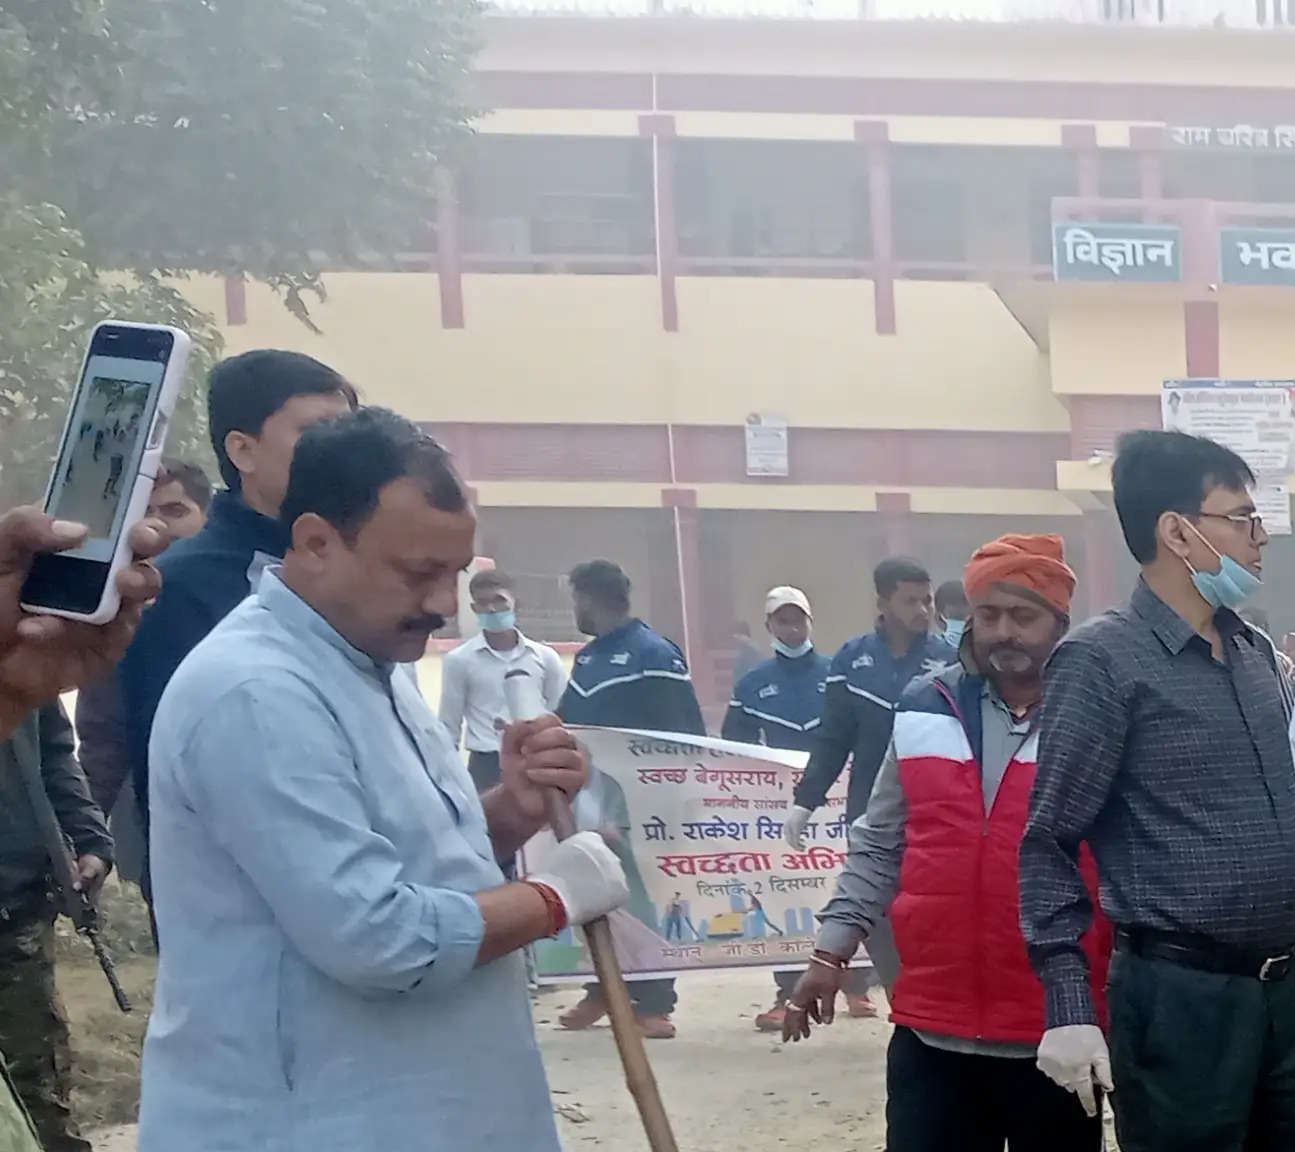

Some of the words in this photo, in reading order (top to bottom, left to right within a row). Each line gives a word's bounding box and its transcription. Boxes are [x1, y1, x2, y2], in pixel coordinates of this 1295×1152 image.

[1063, 228, 1174, 274] विज्ञान
[637, 768, 687, 785] स्वच्छ
[642, 816, 675, 842] प्रो.
[682, 815, 749, 841] राकेश
[657, 851, 771, 878] स्वच्छता
